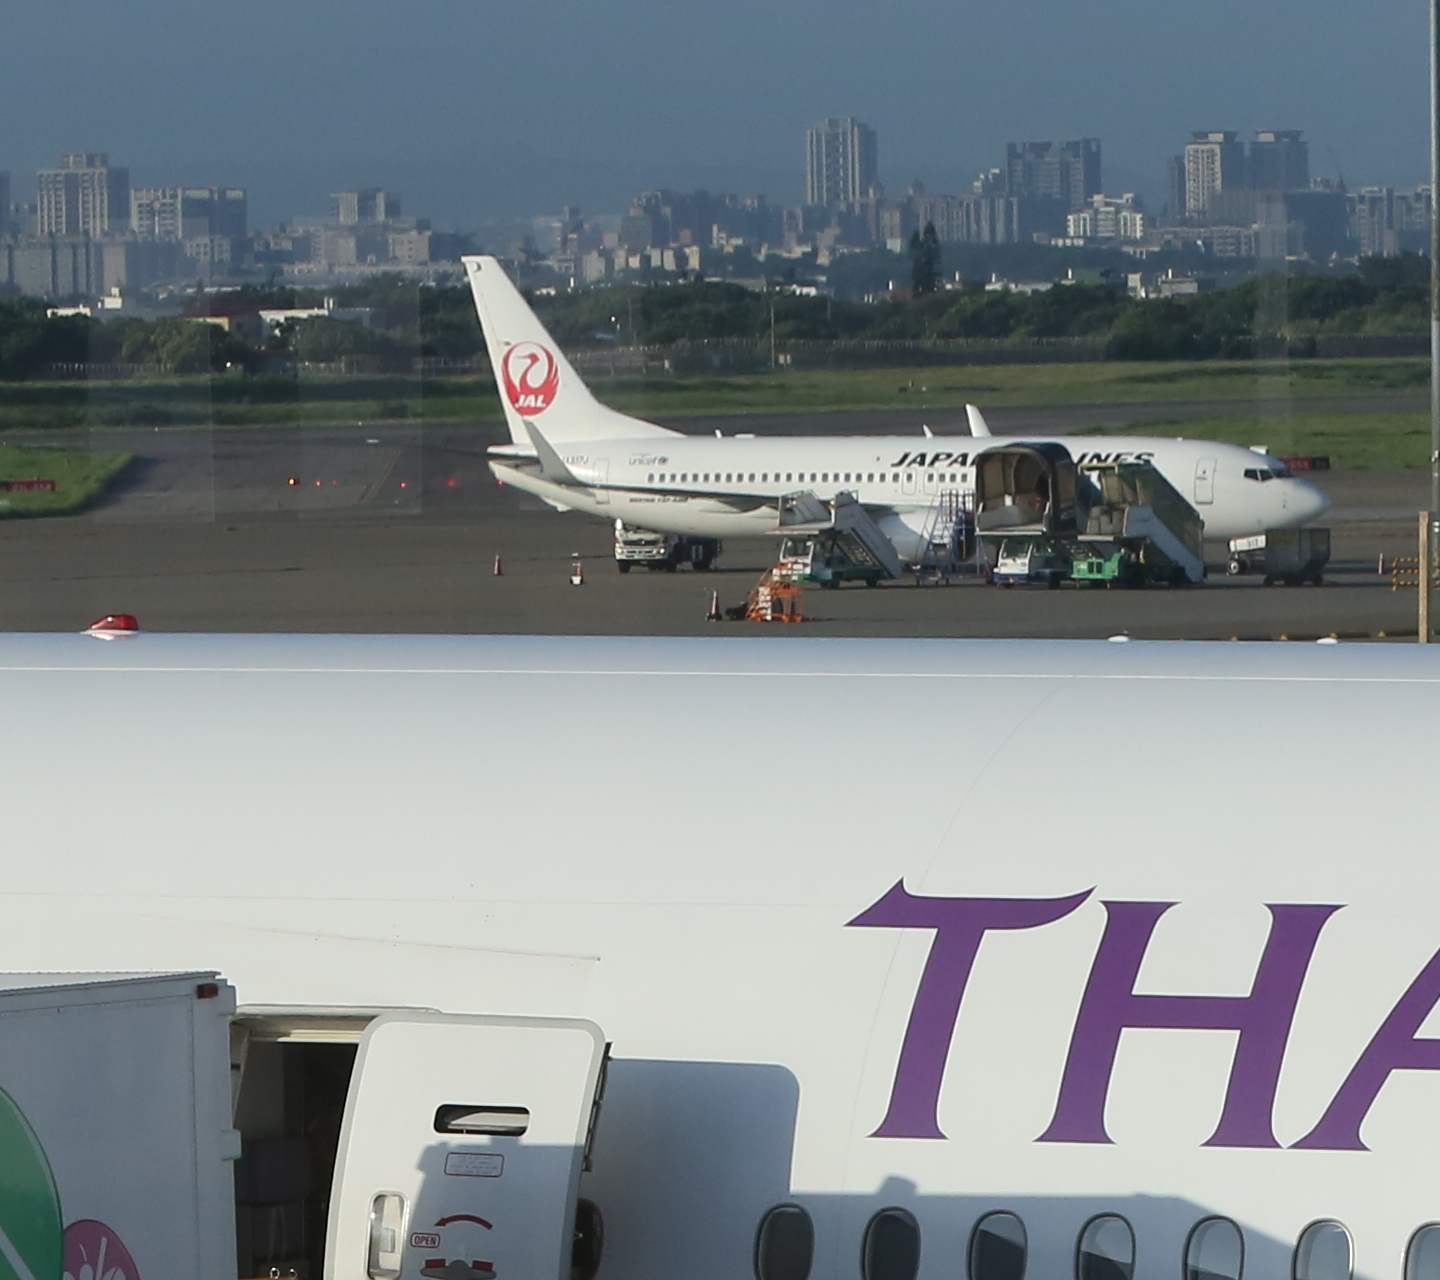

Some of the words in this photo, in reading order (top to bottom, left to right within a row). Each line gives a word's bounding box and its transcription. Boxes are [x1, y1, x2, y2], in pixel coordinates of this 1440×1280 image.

[515, 394, 547, 408] JAL
[890, 451, 978, 468] JAPA
[414, 1235, 437, 1246] OPEN
